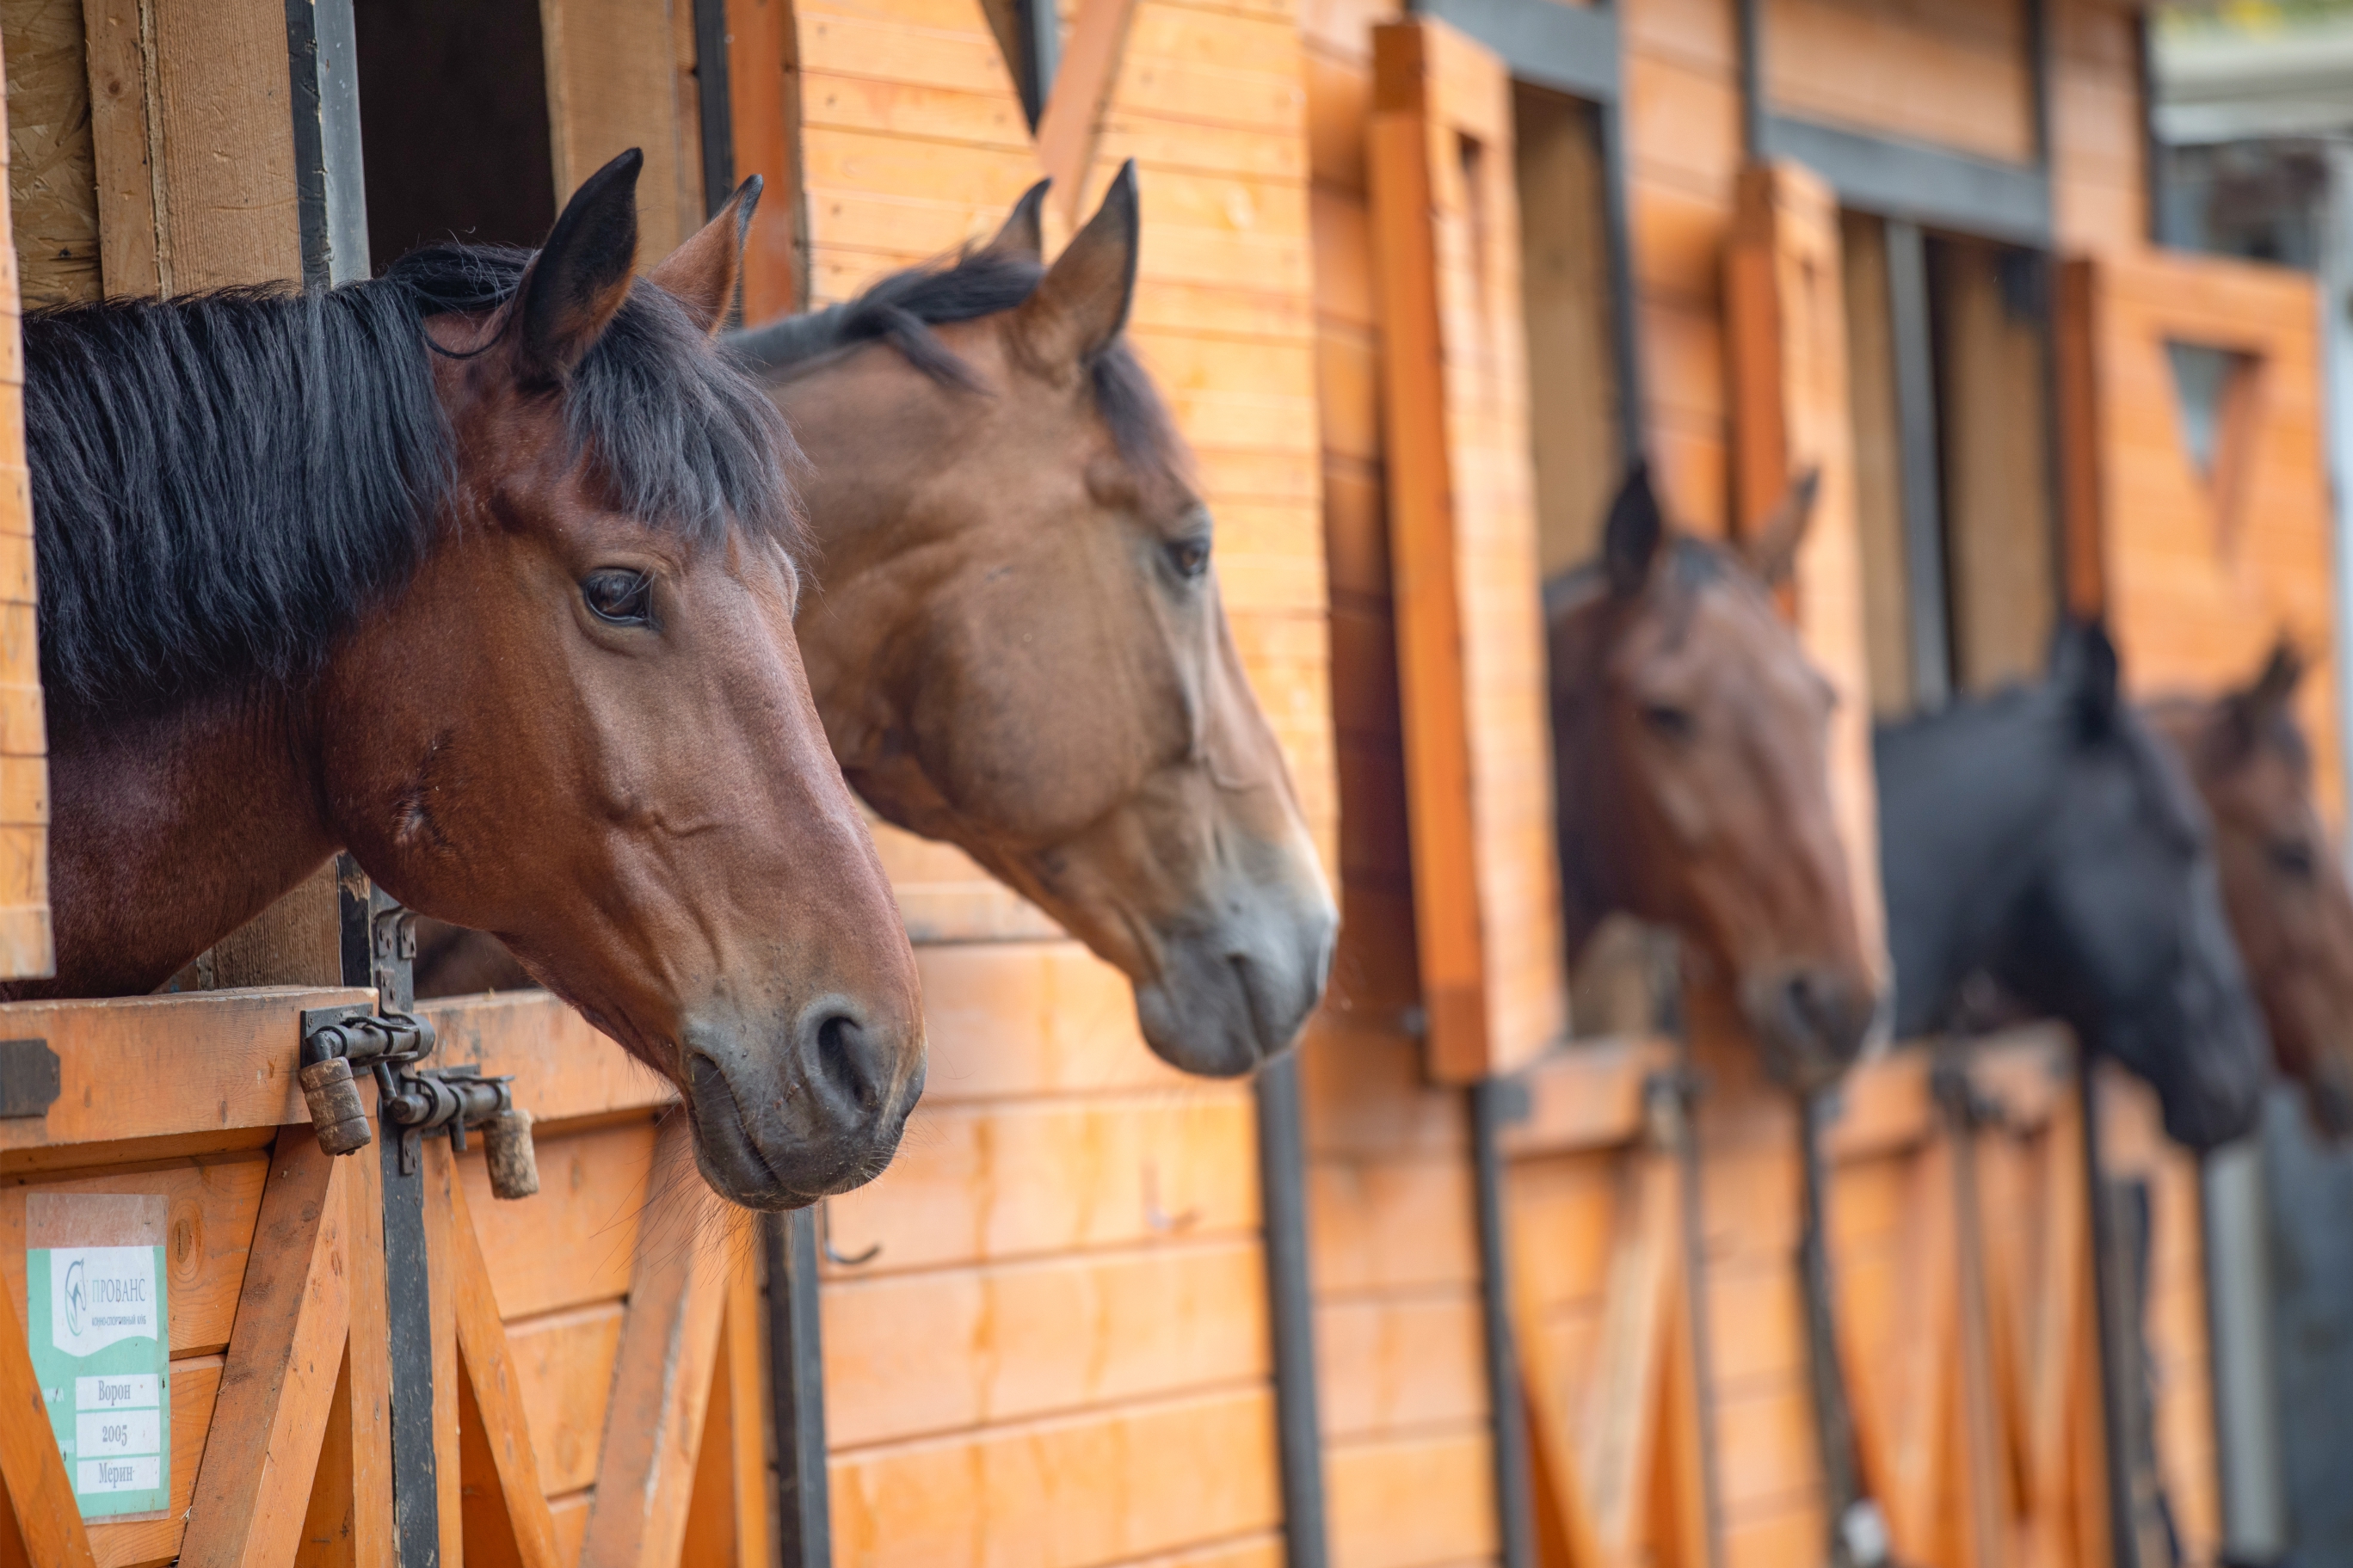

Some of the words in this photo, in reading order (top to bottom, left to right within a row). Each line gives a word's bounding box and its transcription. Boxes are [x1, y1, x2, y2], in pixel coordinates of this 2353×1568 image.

[91, 1278, 146, 1303] ПРОВАНС
[98, 1380, 132, 1406] Ворон
[102, 1424, 128, 1447] 2005
[98, 1462, 133, 1489] Мерин
